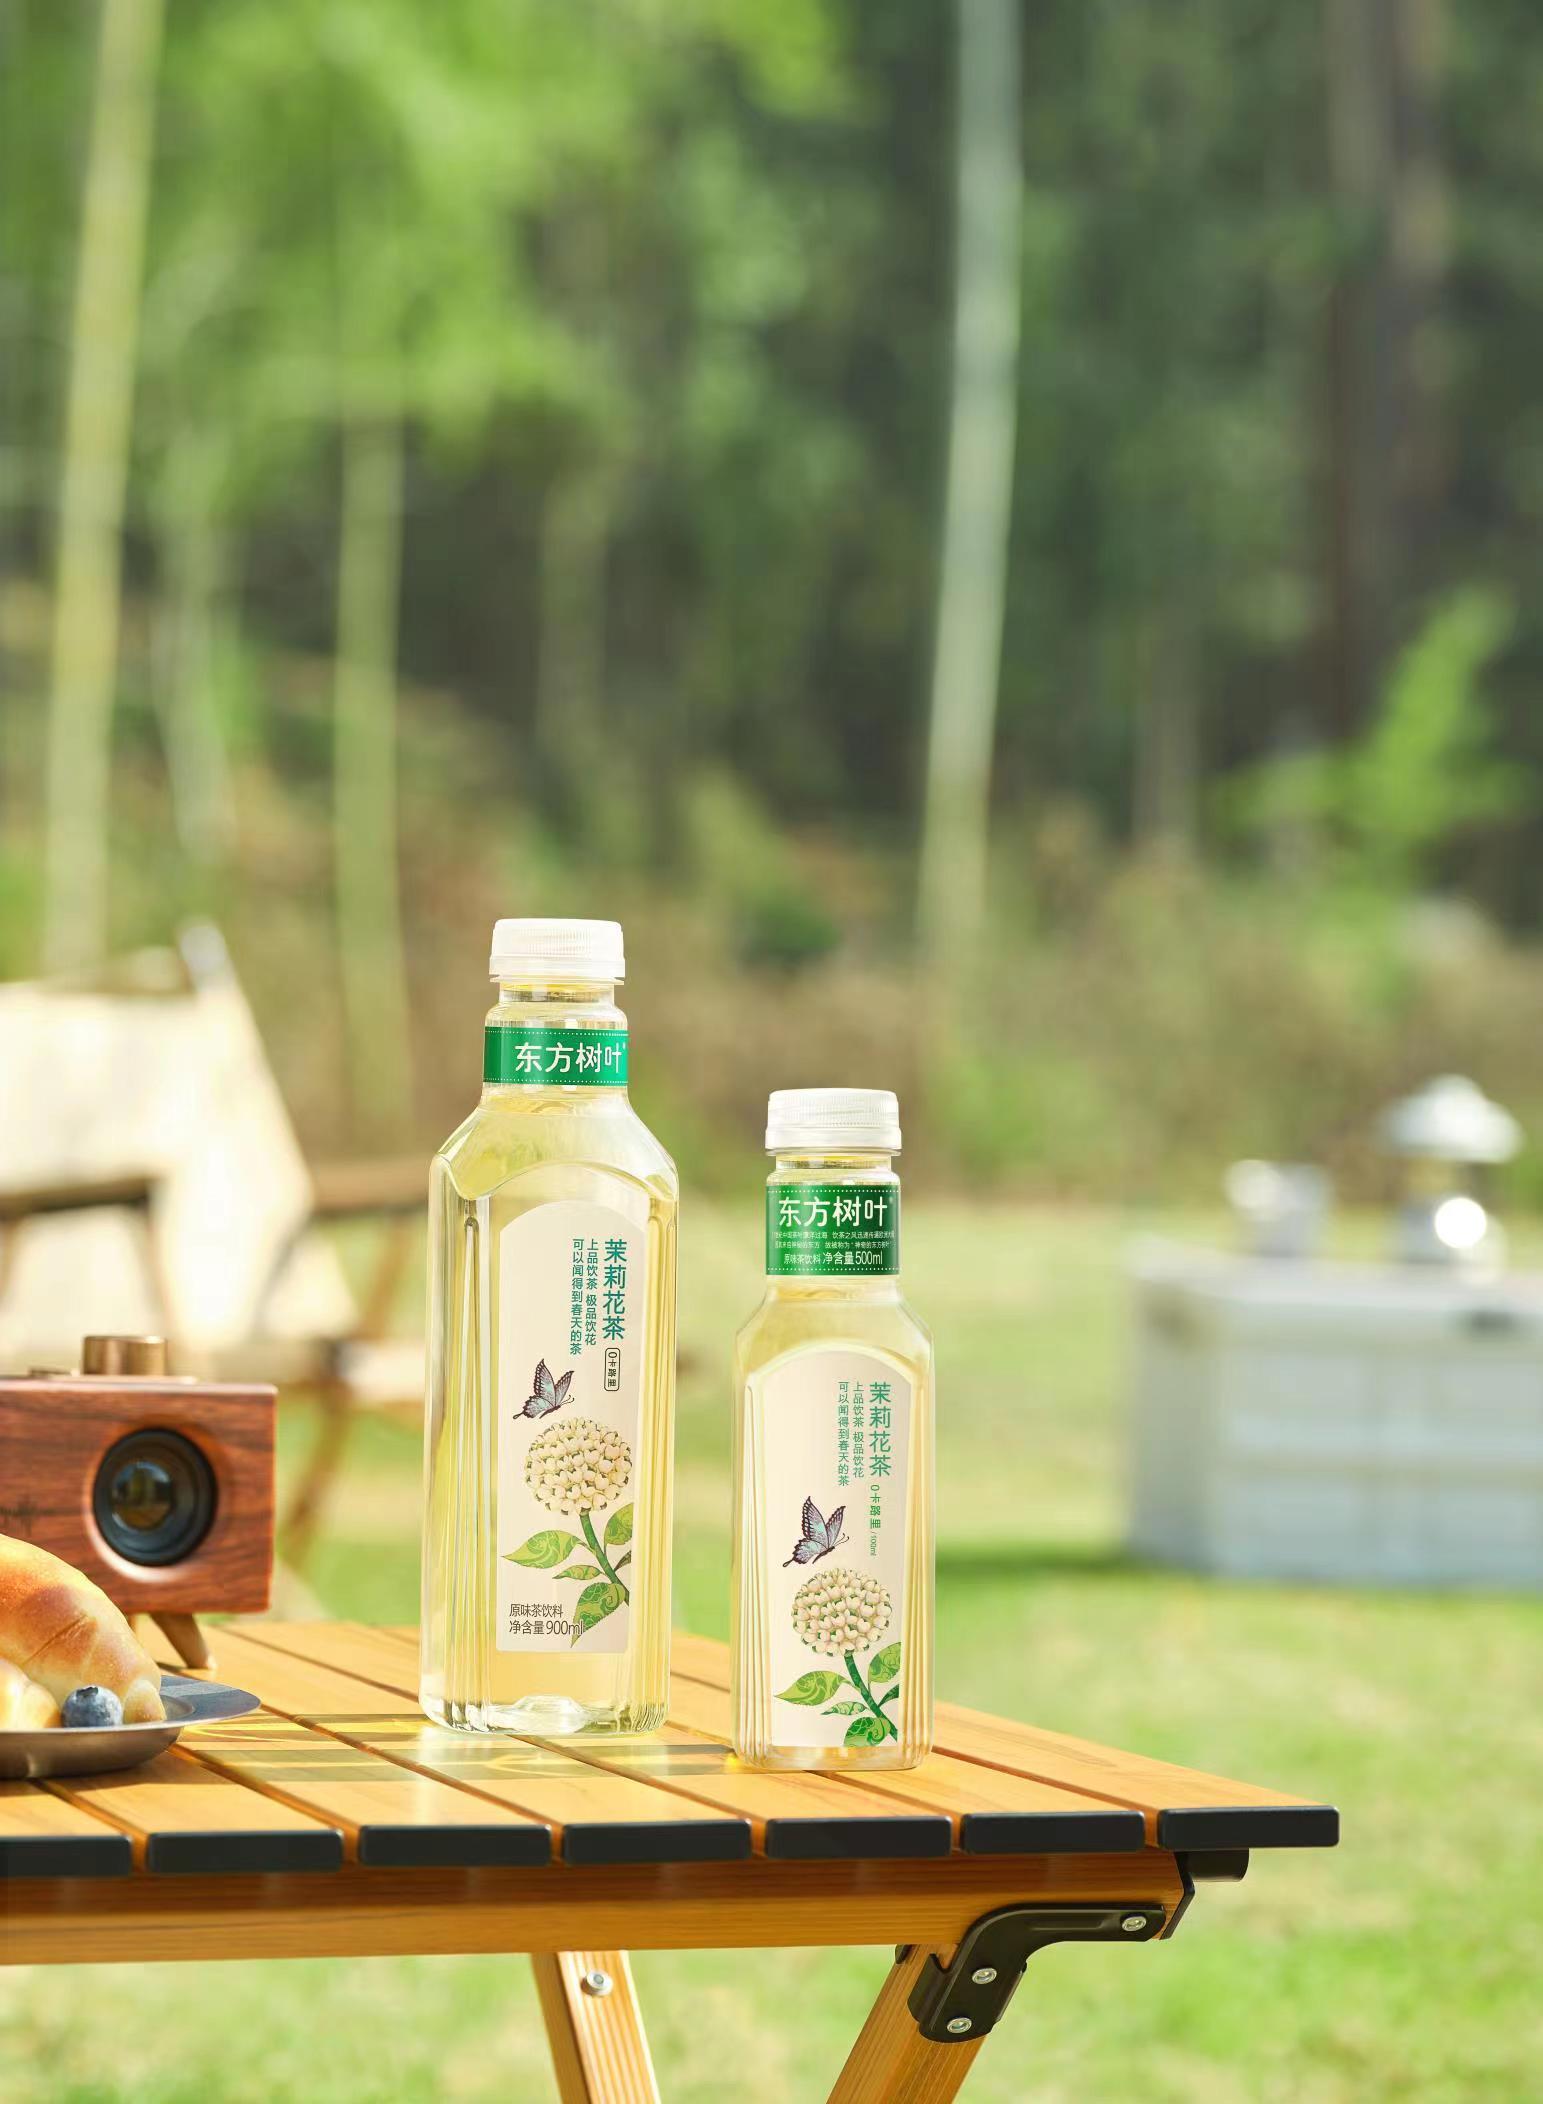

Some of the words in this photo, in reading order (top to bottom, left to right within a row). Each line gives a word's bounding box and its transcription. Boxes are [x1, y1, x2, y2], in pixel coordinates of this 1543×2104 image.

[514, 1042, 622, 1073] 东方树叶
[778, 1195, 888, 1227] 东方树叶
[586, 1238, 599, 1290] 上品饮茶
[783, 1253, 821, 1265] 原味茶饮料
[569, 1238, 584, 1356] 可以闻得到春天的茶
[602, 1238, 628, 1341] 茉莉花茶
[585, 1294, 598, 1346] 极品饮花
[607, 1351, 618, 1388] 0卡路里
[853, 1381, 865, 1428] 上品饮茶
[837, 1381, 850, 1487] 可以闻得到春天的茶
[869, 1381, 891, 1477] 茉莉花茶
[852, 1431, 865, 1478] 极品饮花
[509, 1603, 564, 1618] 原味茶饮料
